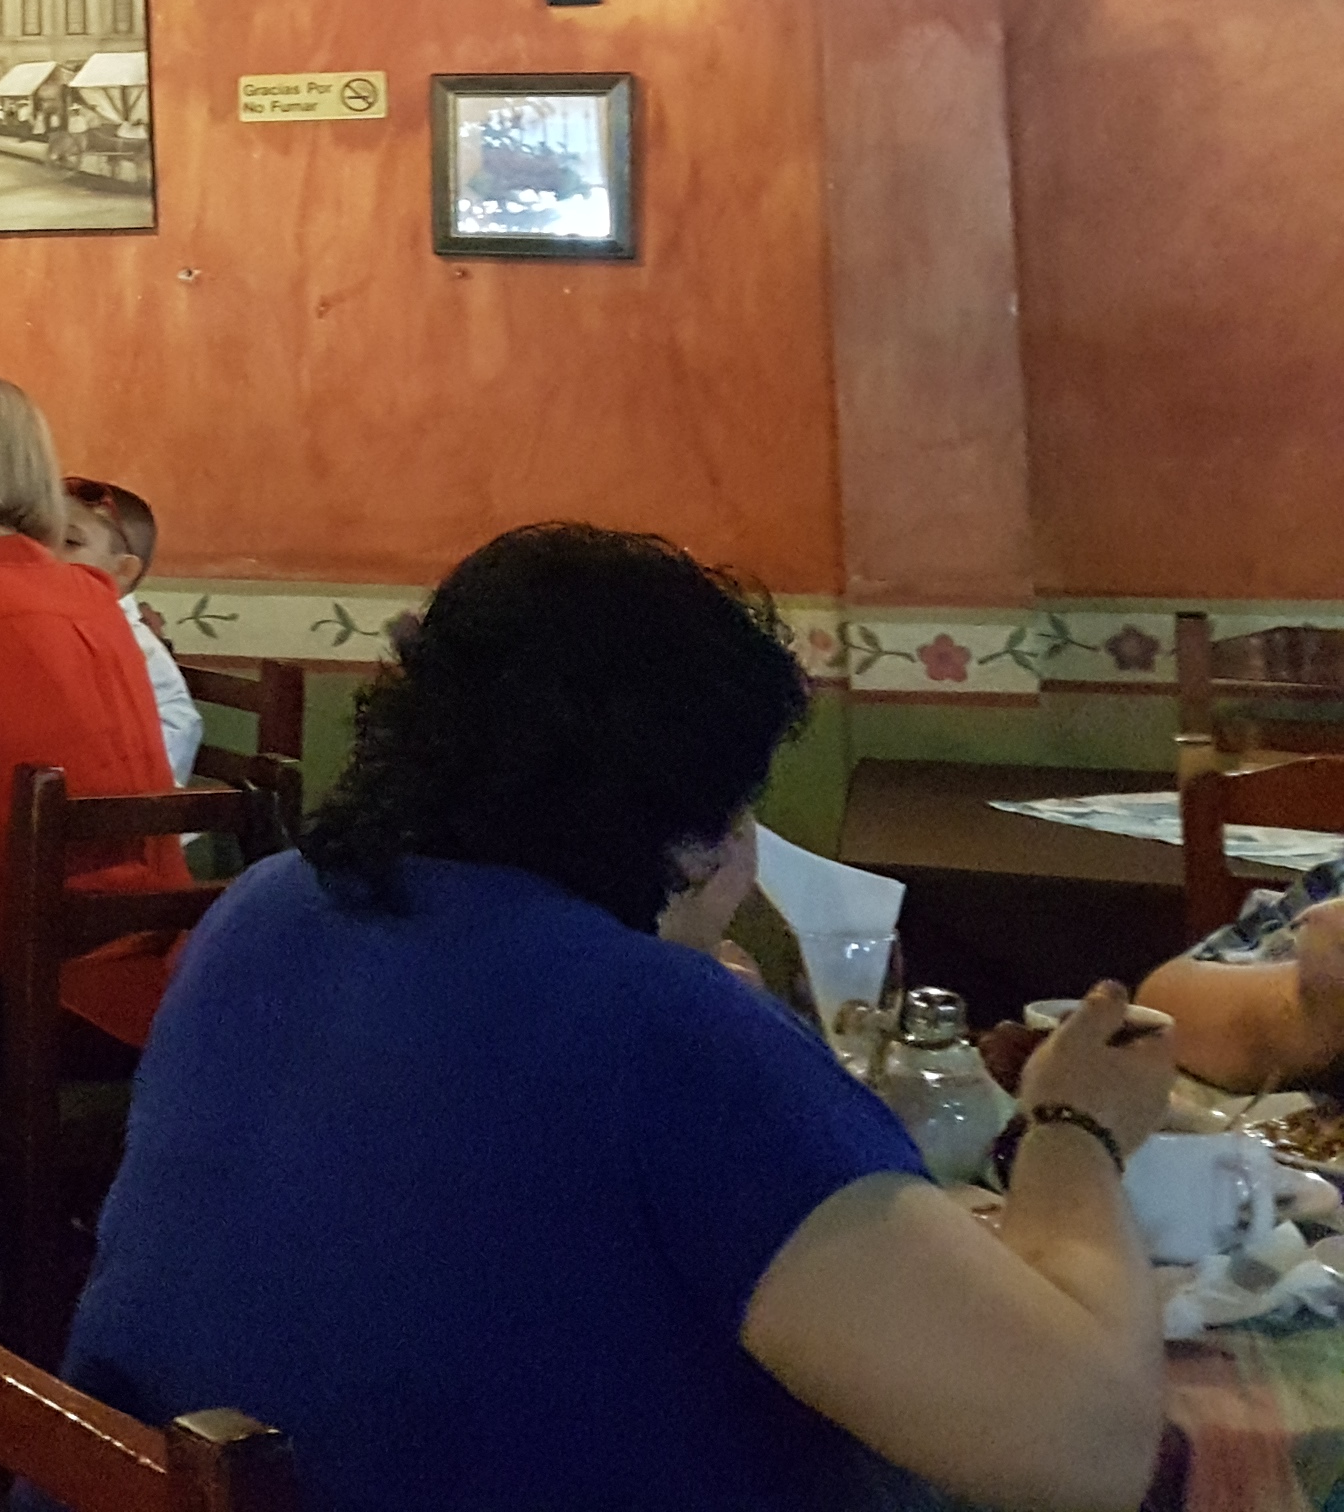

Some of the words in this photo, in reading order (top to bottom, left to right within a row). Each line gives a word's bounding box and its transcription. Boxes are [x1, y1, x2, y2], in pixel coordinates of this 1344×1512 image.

[243, 84, 300, 96] Gracias
[307, 82, 332, 94] Por
[243, 102, 264, 113] No
[270, 100, 318, 112] Fumar
